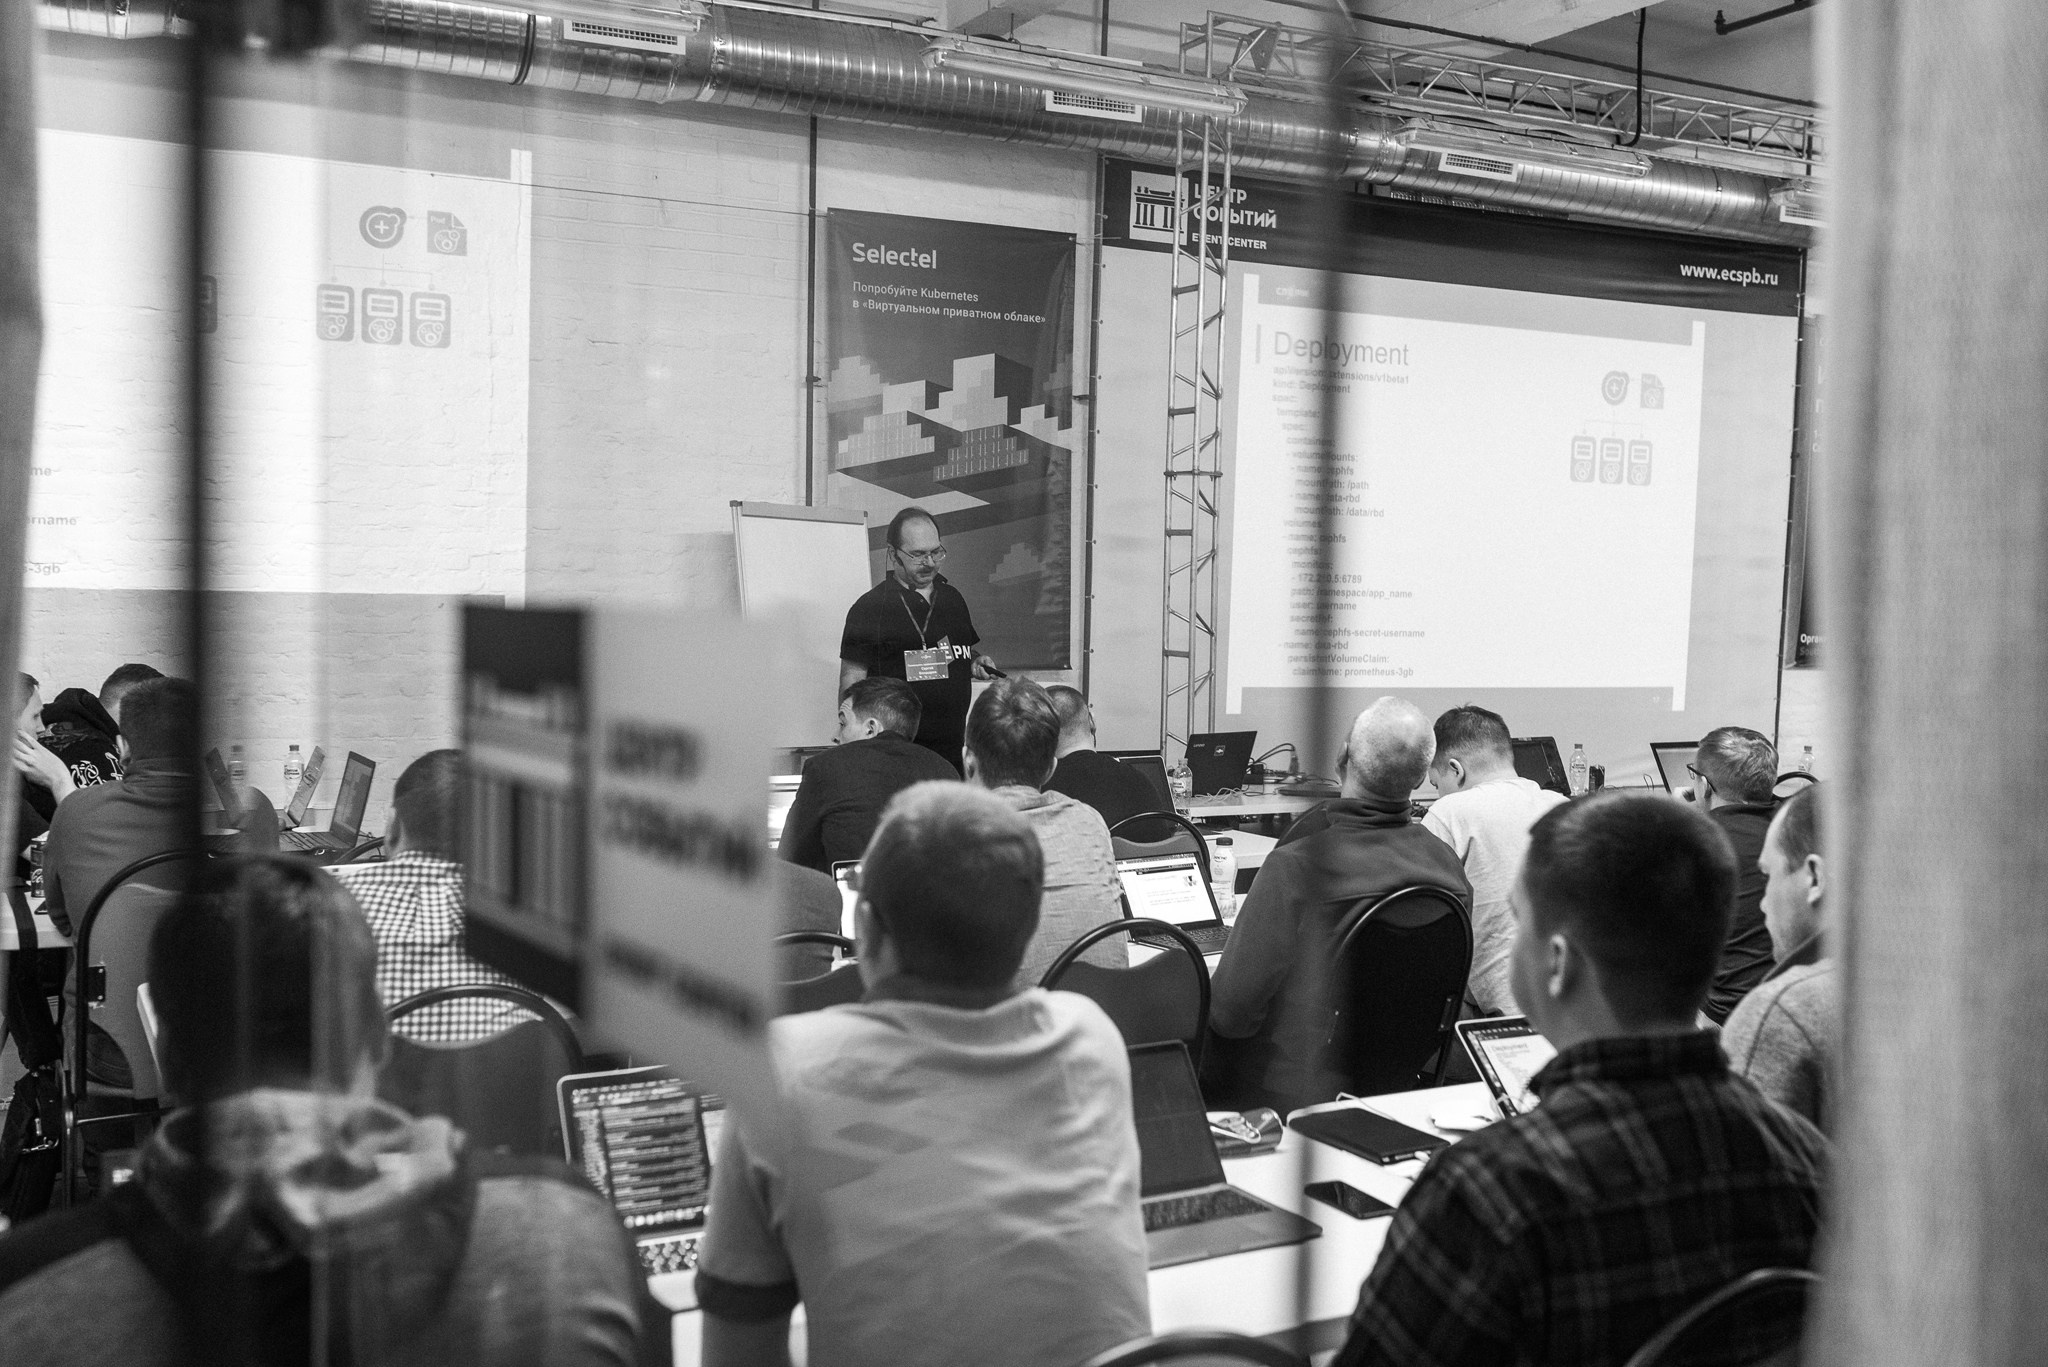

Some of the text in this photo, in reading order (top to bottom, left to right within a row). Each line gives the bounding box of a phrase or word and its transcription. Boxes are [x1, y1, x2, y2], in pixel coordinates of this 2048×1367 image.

[1192, 232, 1267, 250] EENT CENTER
[852, 242, 937, 269] Selectel
[1680, 264, 1779, 287] www.ecspb.ru
[852, 281, 979, 302] Попробуйте Kubernetes
[852, 299, 1046, 324] в «Виртуальном приватном облаке»
[1274, 331, 1409, 367] Deployment
[1346, 507, 1385, 518] /data/rbd
[1344, 667, 1414, 679] prometheus-3gb
